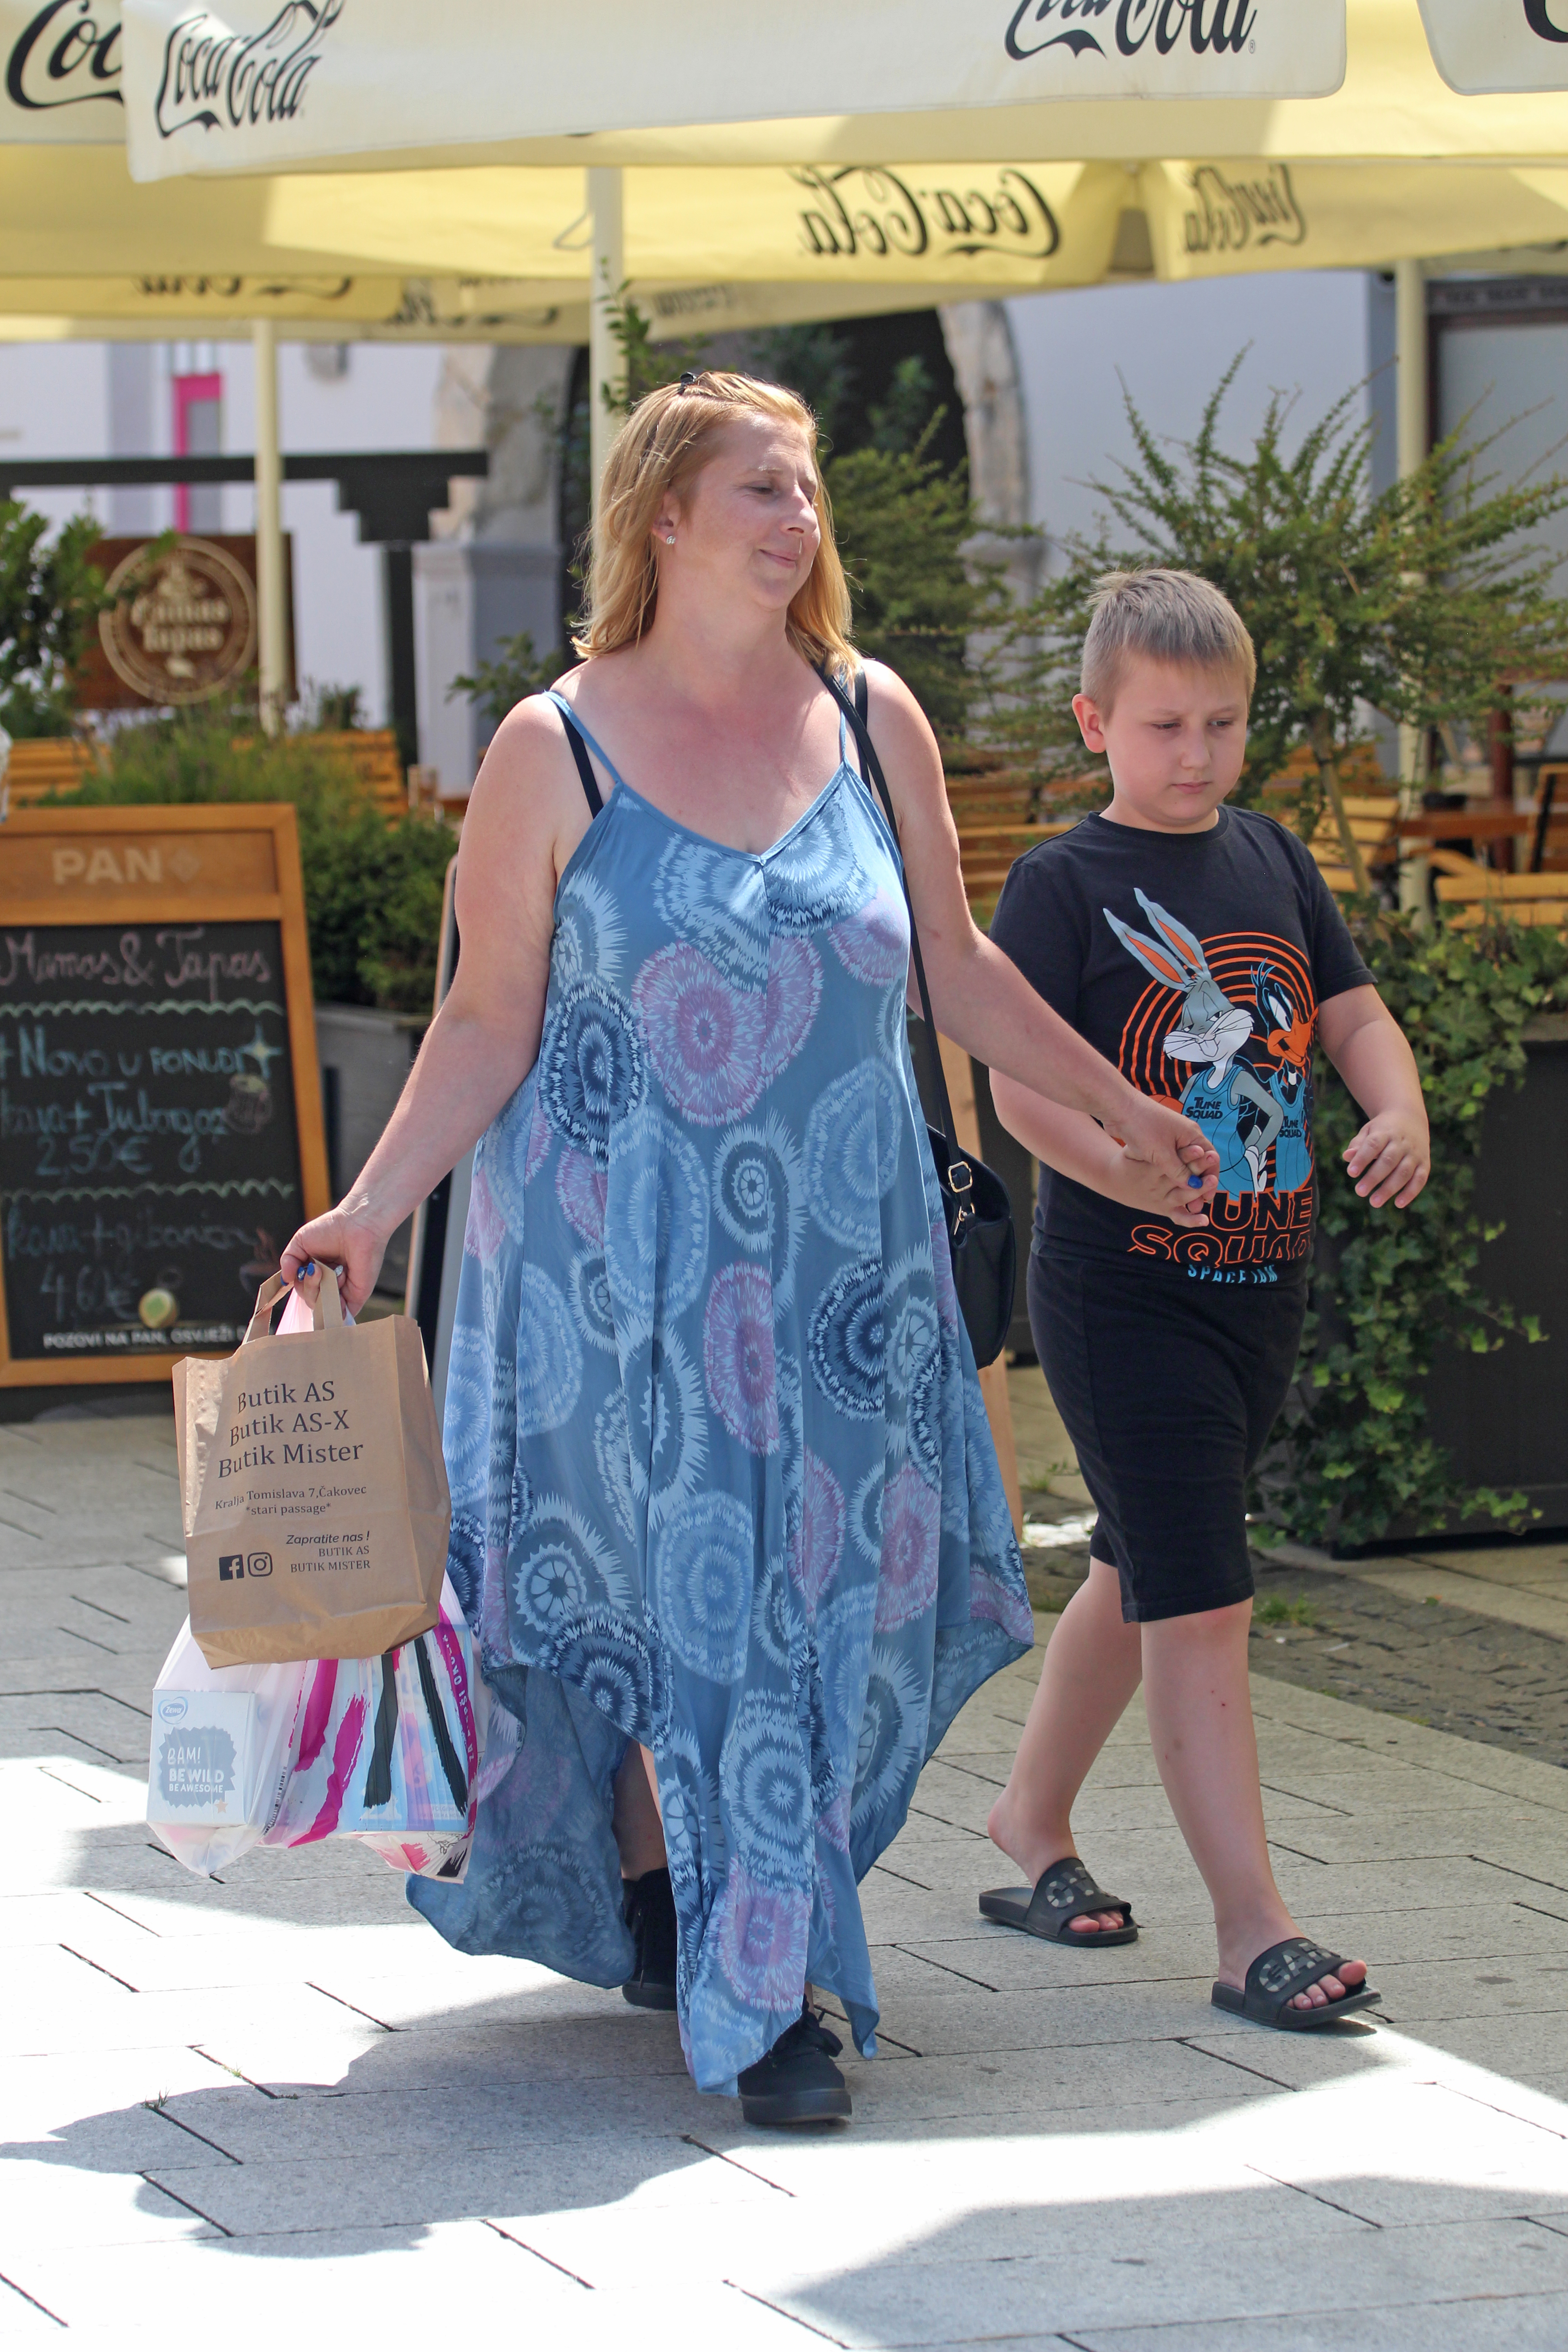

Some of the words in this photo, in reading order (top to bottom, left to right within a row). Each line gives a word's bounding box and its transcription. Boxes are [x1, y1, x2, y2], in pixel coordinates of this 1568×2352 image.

[52, 847, 162, 885] PAN
[156, 926, 271, 1001] Tapas
[1194, 1097, 1221, 1109] TUNE
[1186, 1106, 1223, 1119] SQUAD
[1279, 1126, 1302, 1138] SQUAD
[1207, 1186, 1313, 1231] UNE
[103, 1331, 129, 1346] NA
[237, 1383, 297, 1414] Butik
[303, 1381, 335, 1402] AS
[230, 1413, 284, 1447] Butik
[292, 1409, 350, 1432] AS-X
[218, 1445, 276, 1478] Butik
[282, 1444, 363, 1464] Mister
[215, 1495, 245, 1509] Kralja
[246, 1489, 305, 1500] Tomislava
[286, 1534, 339, 1546] Zapratite
[342, 1533, 363, 1542] nas
[318, 1546, 353, 1557] BUTIK
[356, 1545, 369, 1555] AS
[290, 1562, 325, 1573] BUTIK
[328, 1560, 371, 1570] MISTER
[168, 1747, 201, 1764] BAM!
[169, 1768, 186, 1783] BE
[186, 1769, 225, 1783] WILD
[169, 1784, 179, 1792] BE
[181, 1784, 224, 1793] AWESOME
